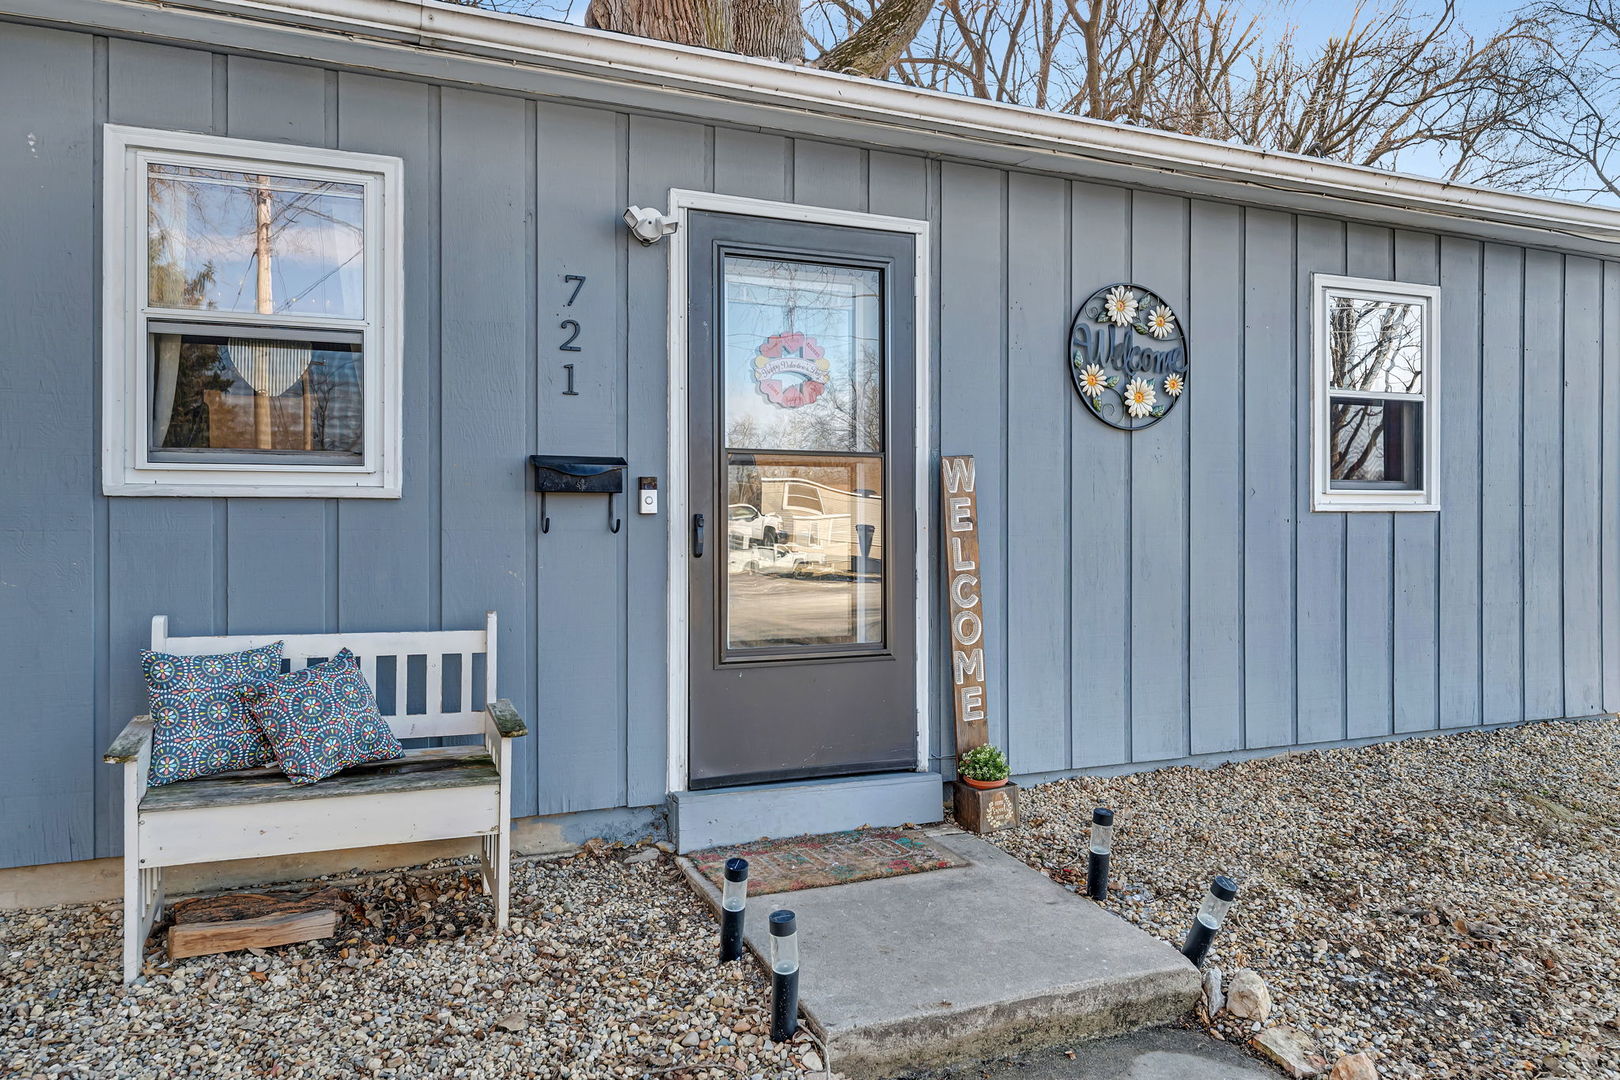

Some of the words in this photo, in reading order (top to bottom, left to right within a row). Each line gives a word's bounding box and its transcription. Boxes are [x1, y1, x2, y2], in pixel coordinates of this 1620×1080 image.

[559, 274, 587, 396] 721
[1072, 322, 1189, 376] Welcome
[941, 457, 985, 722] WELCOME
